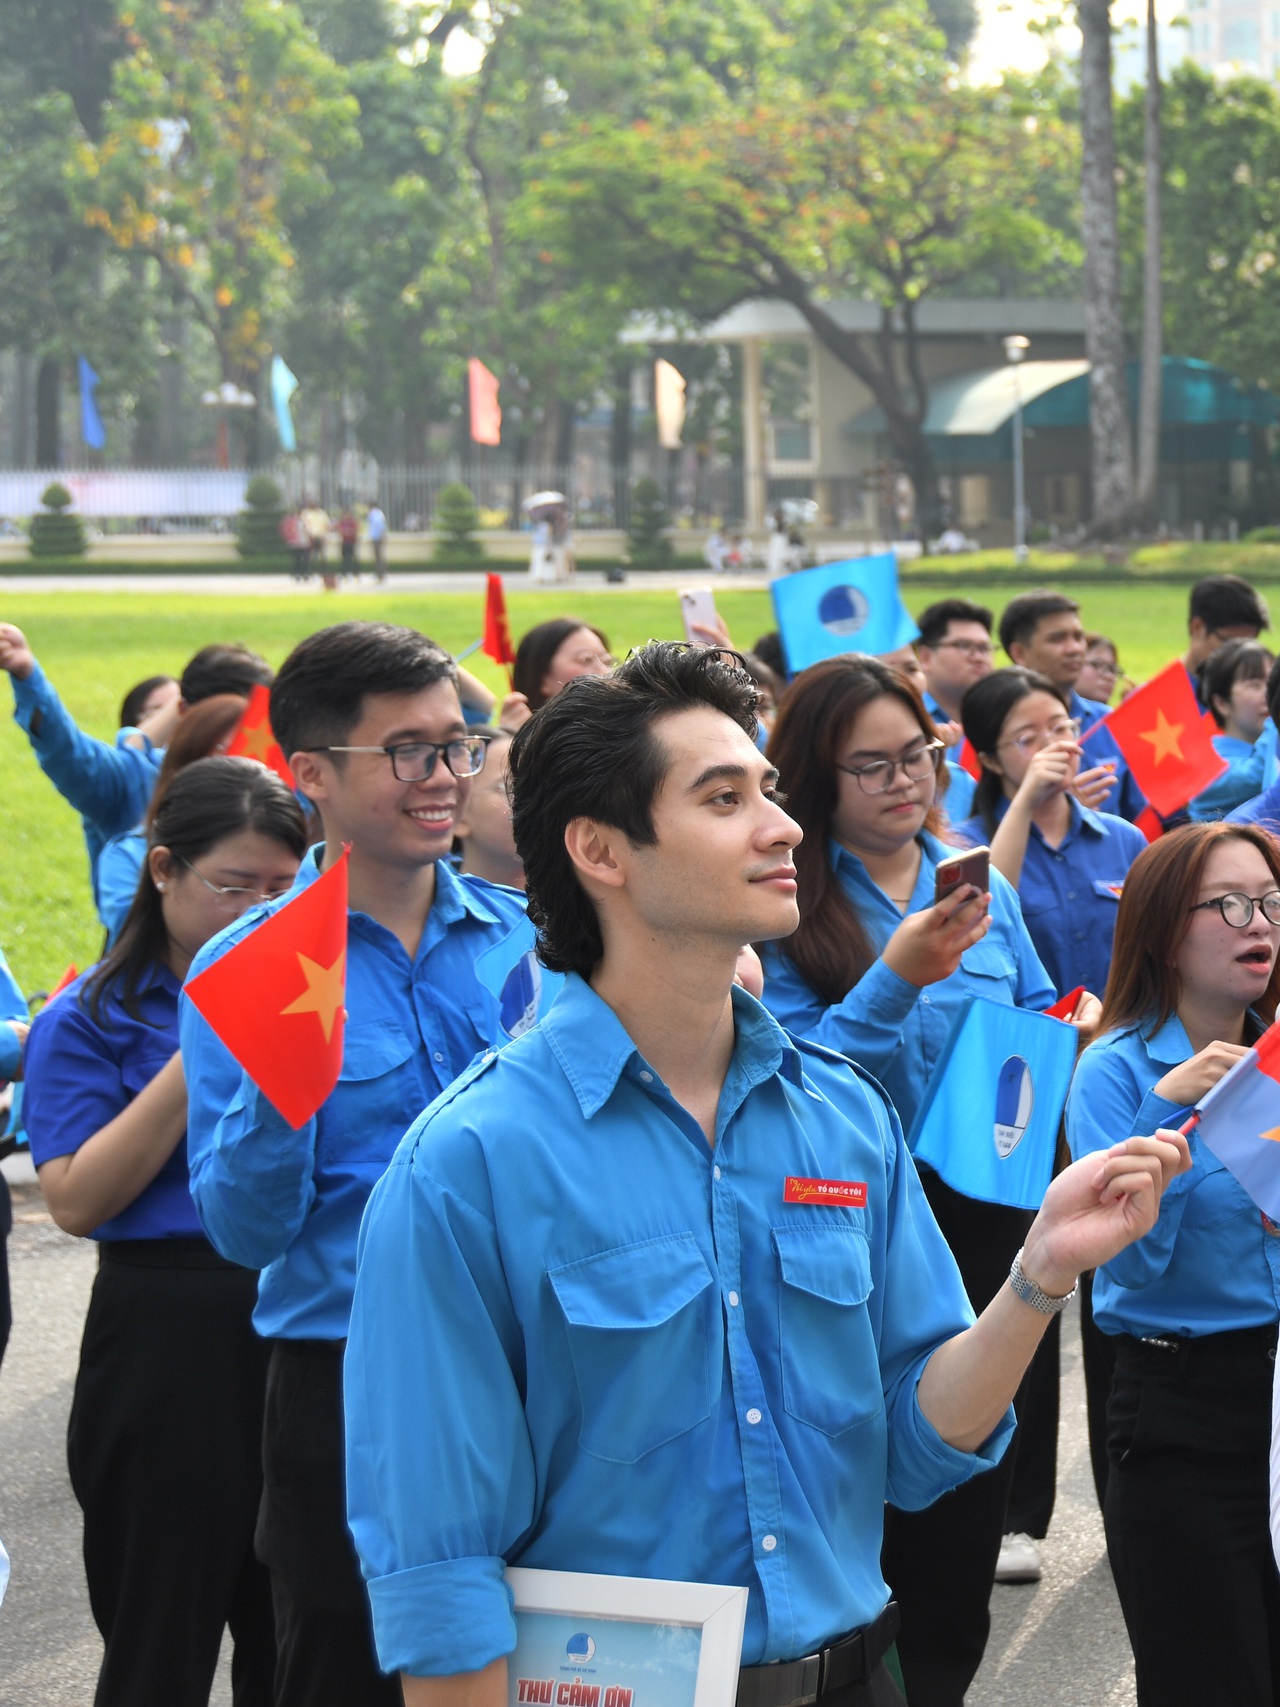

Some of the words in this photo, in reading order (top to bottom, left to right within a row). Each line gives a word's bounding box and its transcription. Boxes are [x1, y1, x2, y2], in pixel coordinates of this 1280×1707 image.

[518, 1679, 554, 1704] THƯ
[557, 1677, 600, 1707] CẢM
[604, 1685, 632, 1707] ƠN
